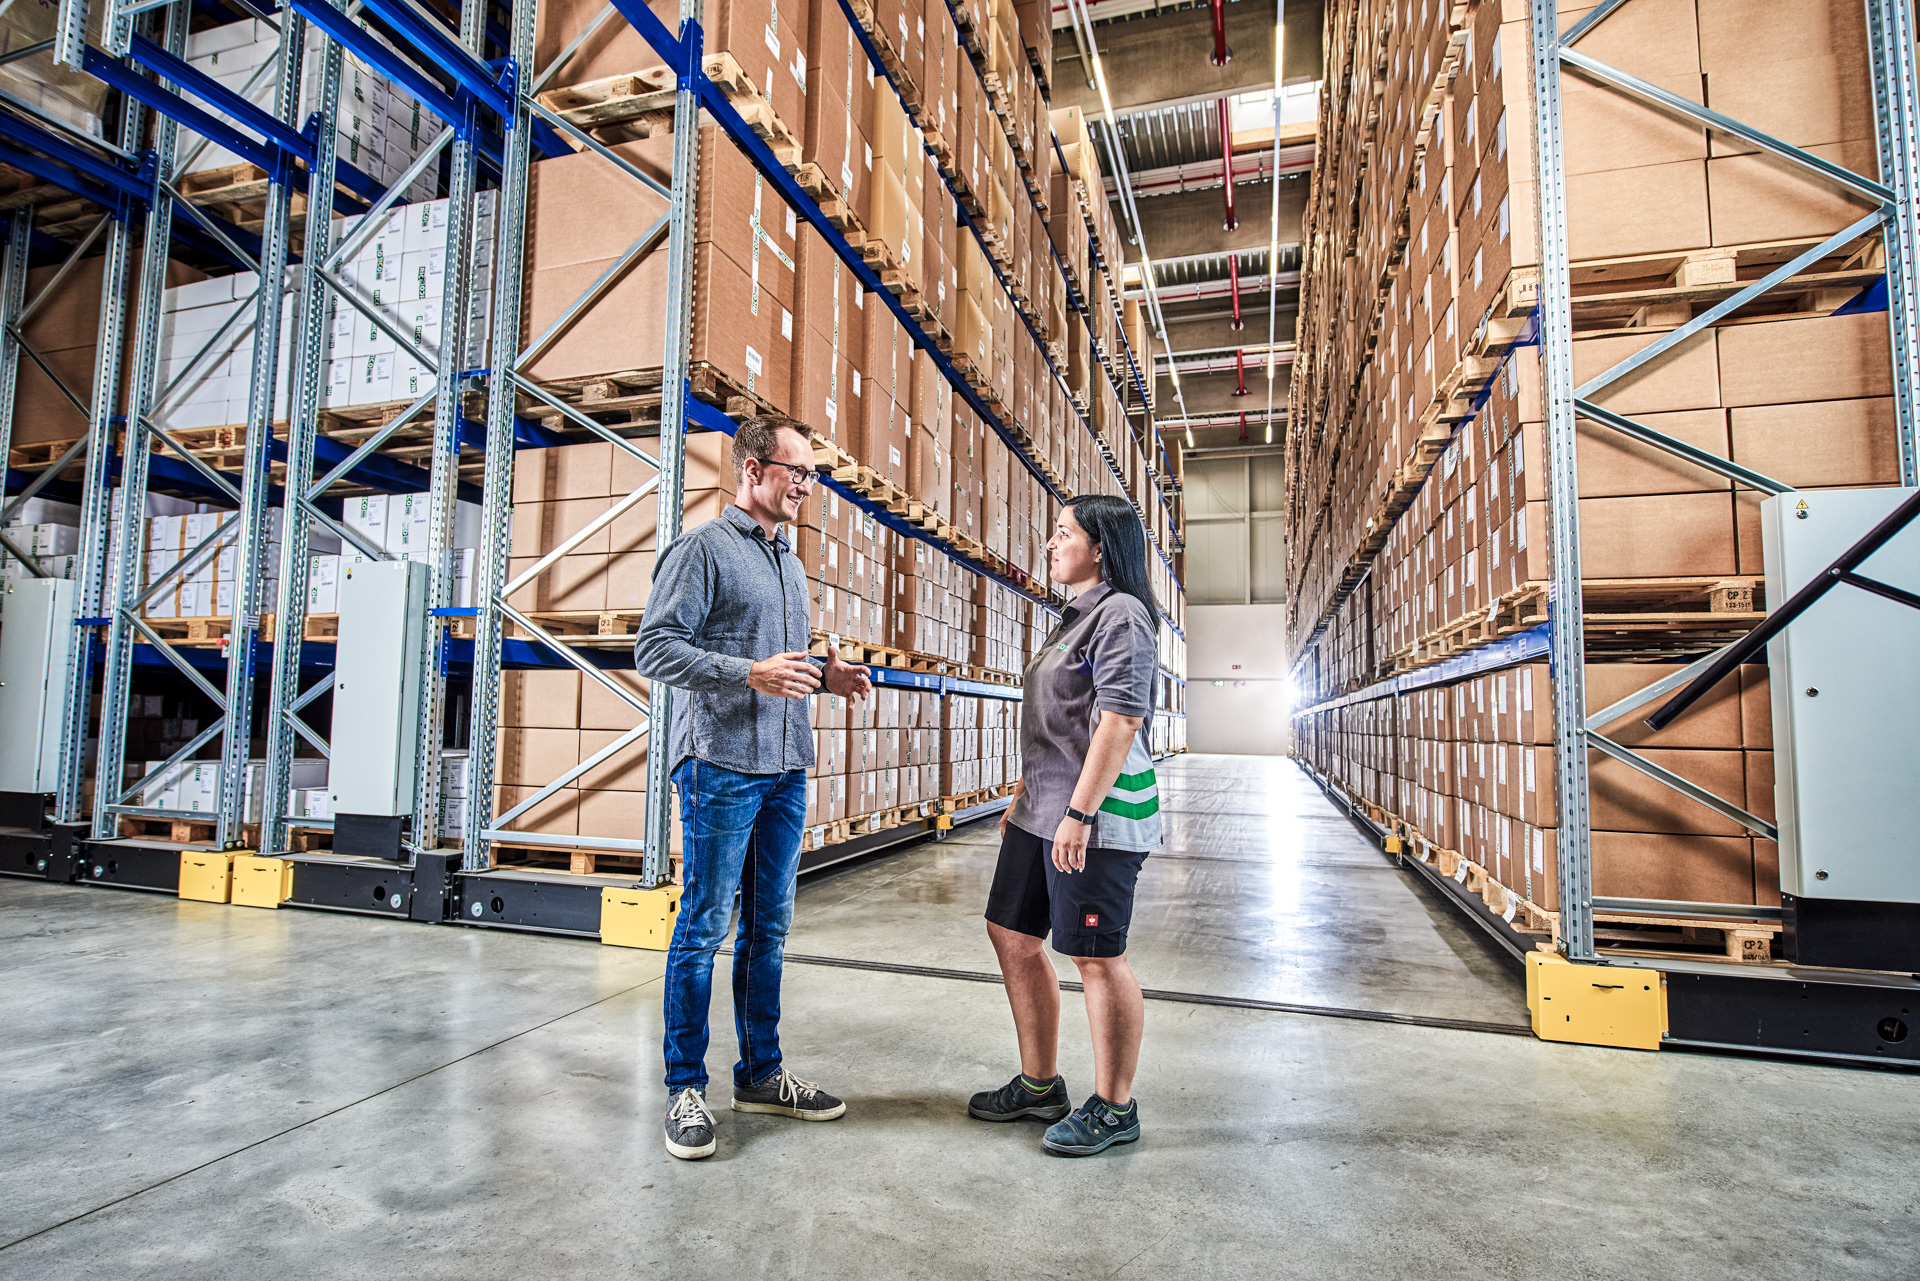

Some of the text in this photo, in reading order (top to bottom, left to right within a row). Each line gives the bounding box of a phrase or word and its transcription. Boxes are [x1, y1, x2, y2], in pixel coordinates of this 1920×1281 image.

[1728, 591, 1748, 600] CP 2
[1744, 940, 1763, 949] CP 2
